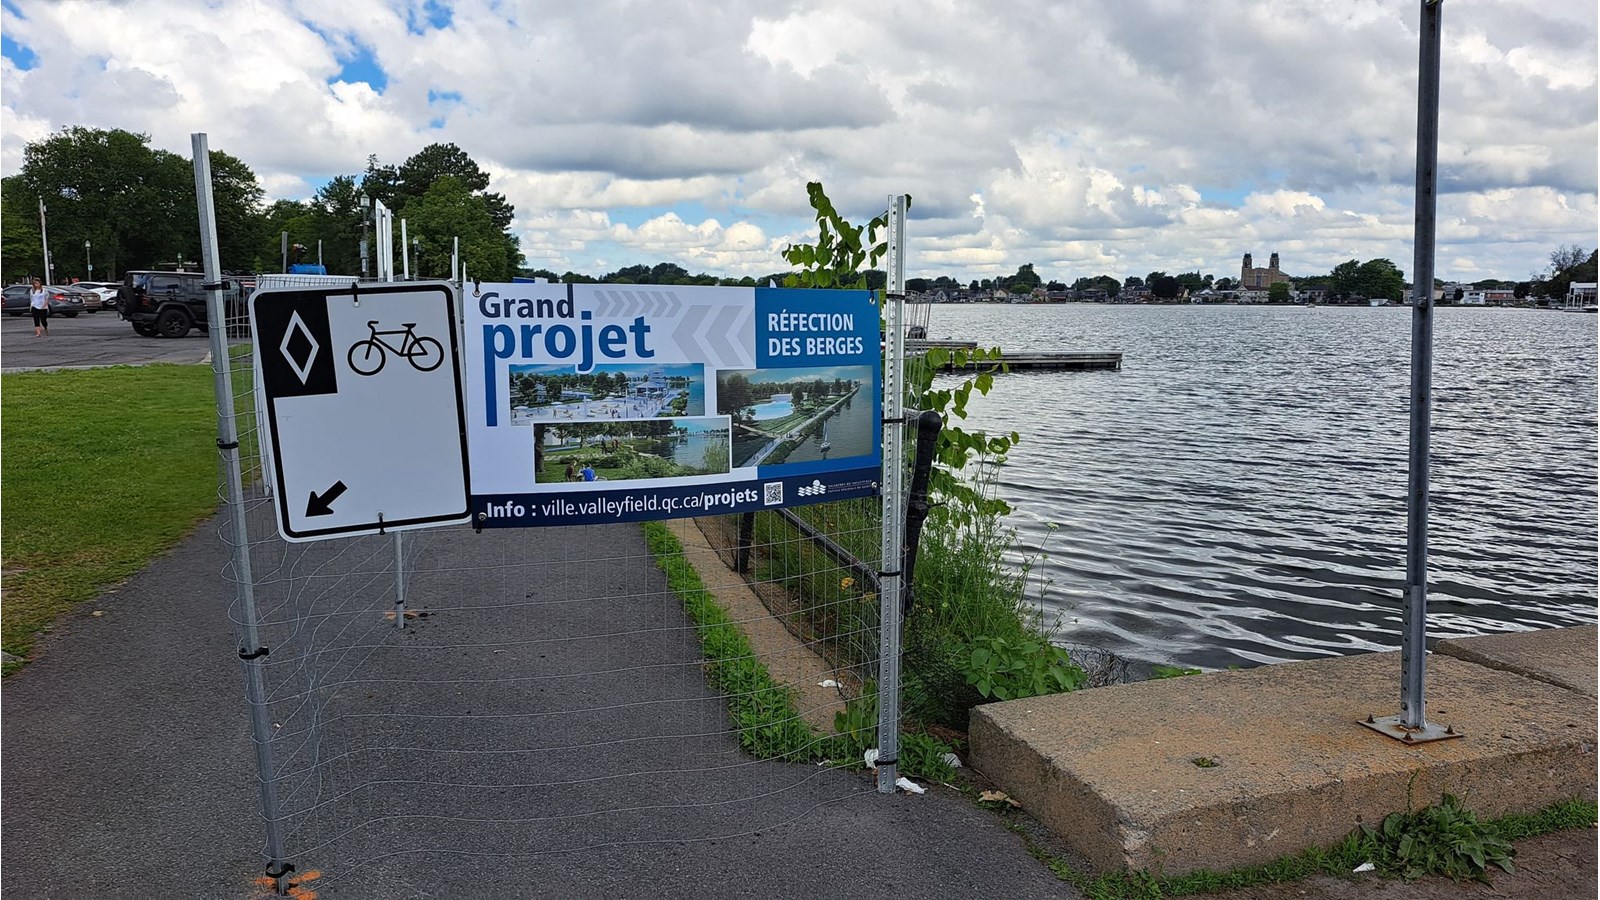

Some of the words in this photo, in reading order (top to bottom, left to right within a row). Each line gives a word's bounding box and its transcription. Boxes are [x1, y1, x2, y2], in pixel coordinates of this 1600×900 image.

[479, 284, 575, 318] Grand
[768, 308, 853, 332] RÉFECTION
[768, 338, 802, 357] DES
[806, 336, 863, 355] BERGES
[483, 310, 655, 427] projet
[487, 502, 525, 518] Info
[542, 488, 758, 517] ville.valleyfield.qc.ca/projets
